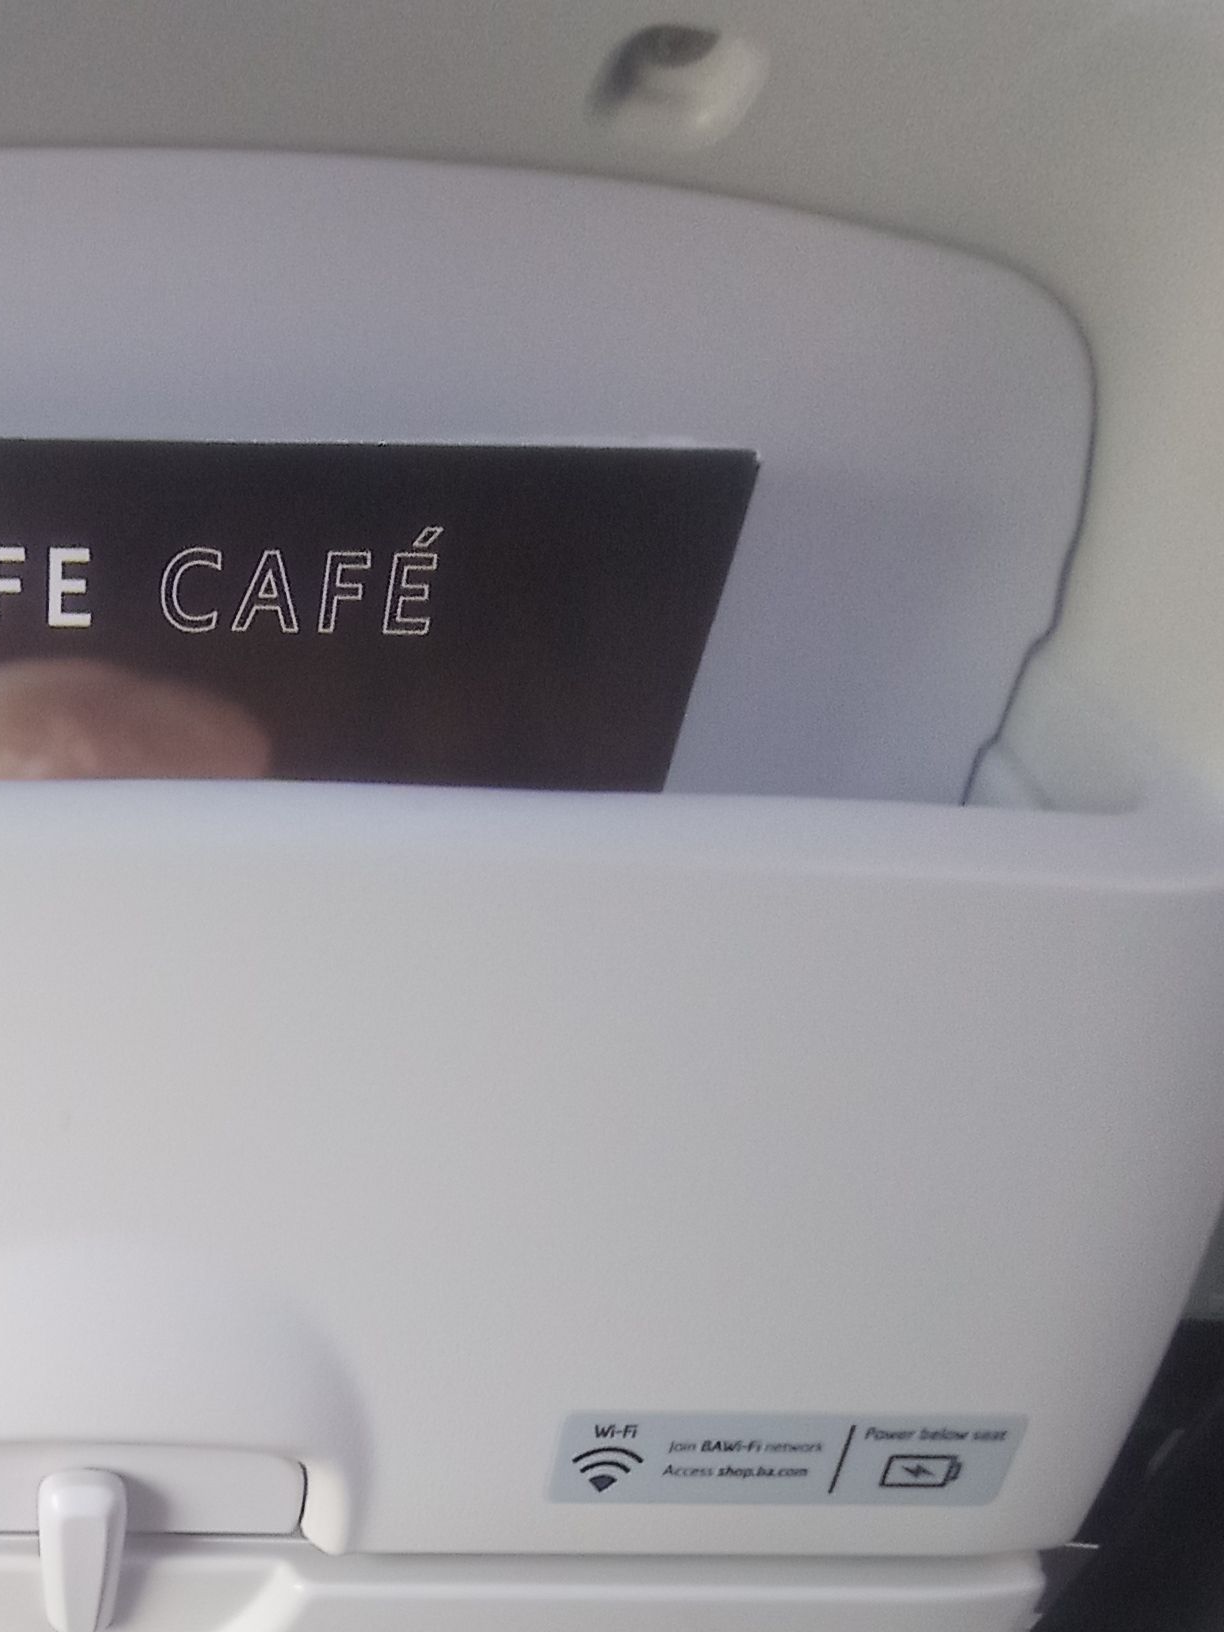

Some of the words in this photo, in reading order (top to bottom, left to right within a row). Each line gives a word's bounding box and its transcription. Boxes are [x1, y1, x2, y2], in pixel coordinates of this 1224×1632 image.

[160, 526, 444, 635] CAFÉ
[594, 1423, 639, 1440] Wi-Fi
[864, 1426, 914, 1440] Power
[918, 1427, 969, 1441] below
[972, 1428, 1008, 1441] seat
[668, 1440, 697, 1454] Join
[764, 1441, 824, 1454] network
[662, 1465, 715, 1478] Access
[717, 1465, 808, 1480] shop.ba.com
